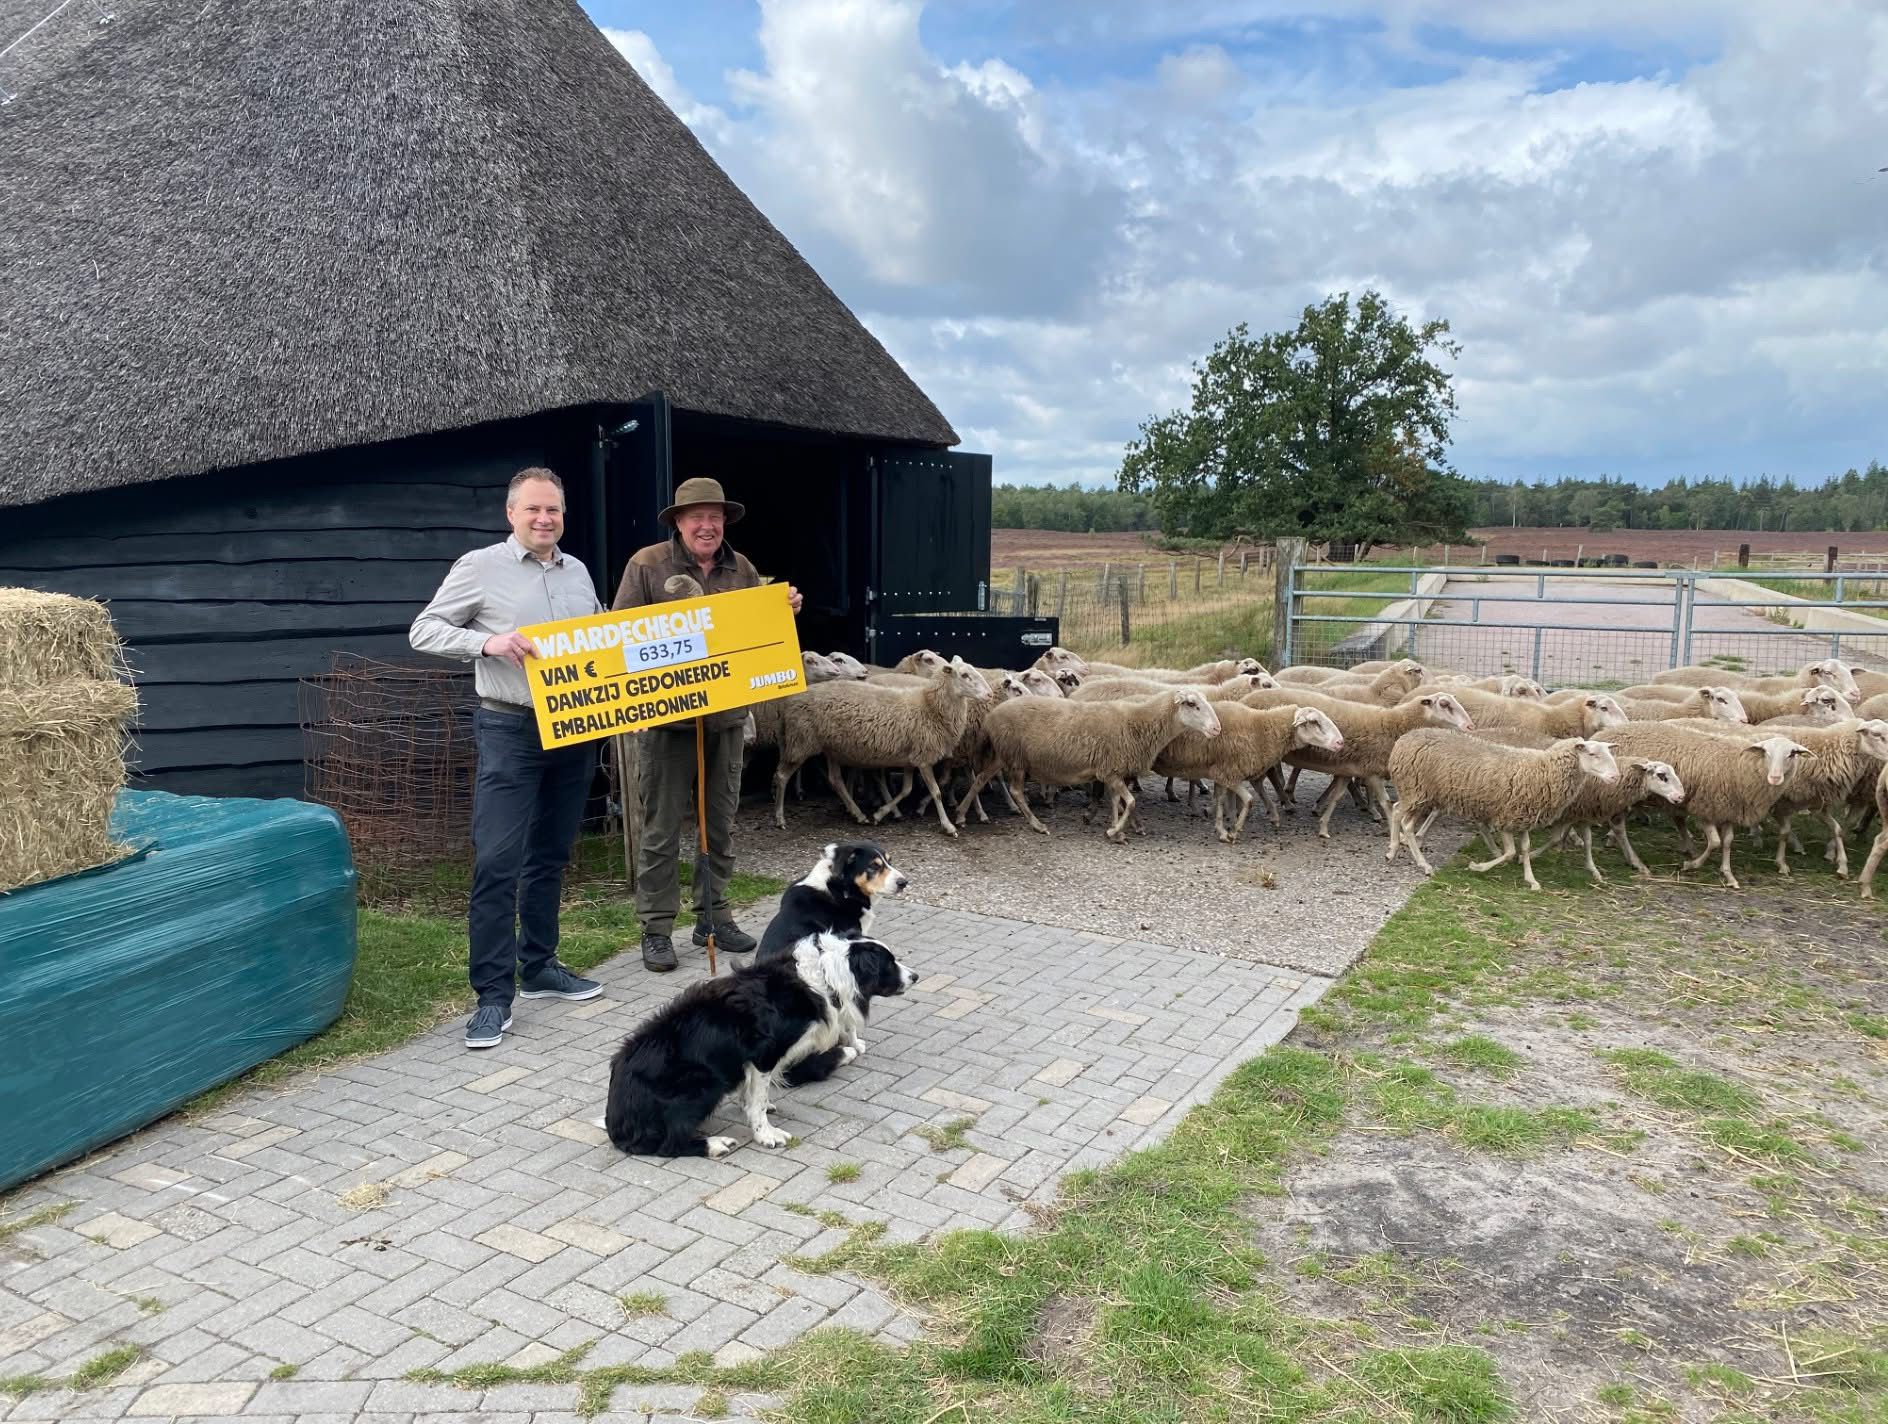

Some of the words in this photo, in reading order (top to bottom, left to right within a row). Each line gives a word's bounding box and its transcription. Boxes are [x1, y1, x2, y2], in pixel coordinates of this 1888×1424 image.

[532, 606, 714, 660] WAARDECHEQUE
[539, 664, 579, 687] VAN
[584, 660, 598, 679] €
[639, 639, 693, 662] 633,75
[545, 683, 620, 714] DANKZIJ
[625, 660, 731, 697] GEDONEERDE
[749, 669, 798, 690] JUMBO
[551, 690, 709, 740] EMBALLAGEBONNEN
